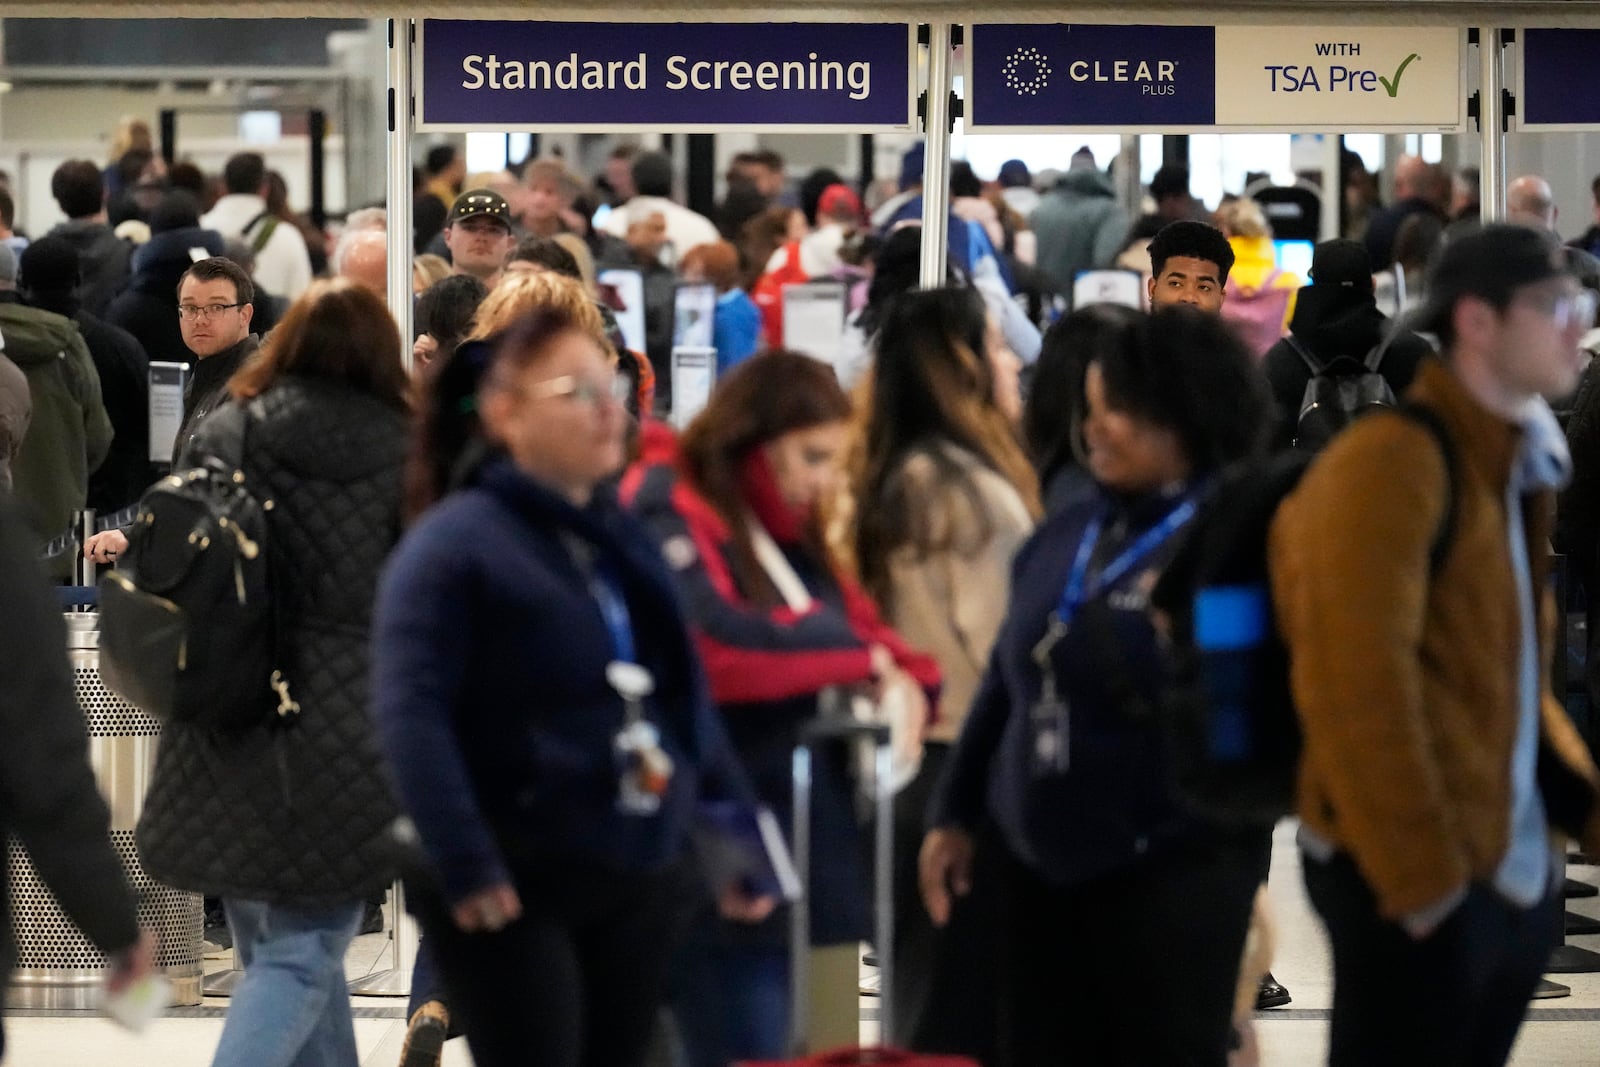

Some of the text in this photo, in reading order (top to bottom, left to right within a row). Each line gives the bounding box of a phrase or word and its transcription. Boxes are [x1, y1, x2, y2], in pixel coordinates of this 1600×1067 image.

[1315, 43, 1361, 56] WITH
[462, 53, 871, 99] Standard Screening
[1069, 60, 1175, 82] CLEAR
[1264, 65, 1377, 92] TSA Pre
[1142, 85, 1175, 95] PLUS
